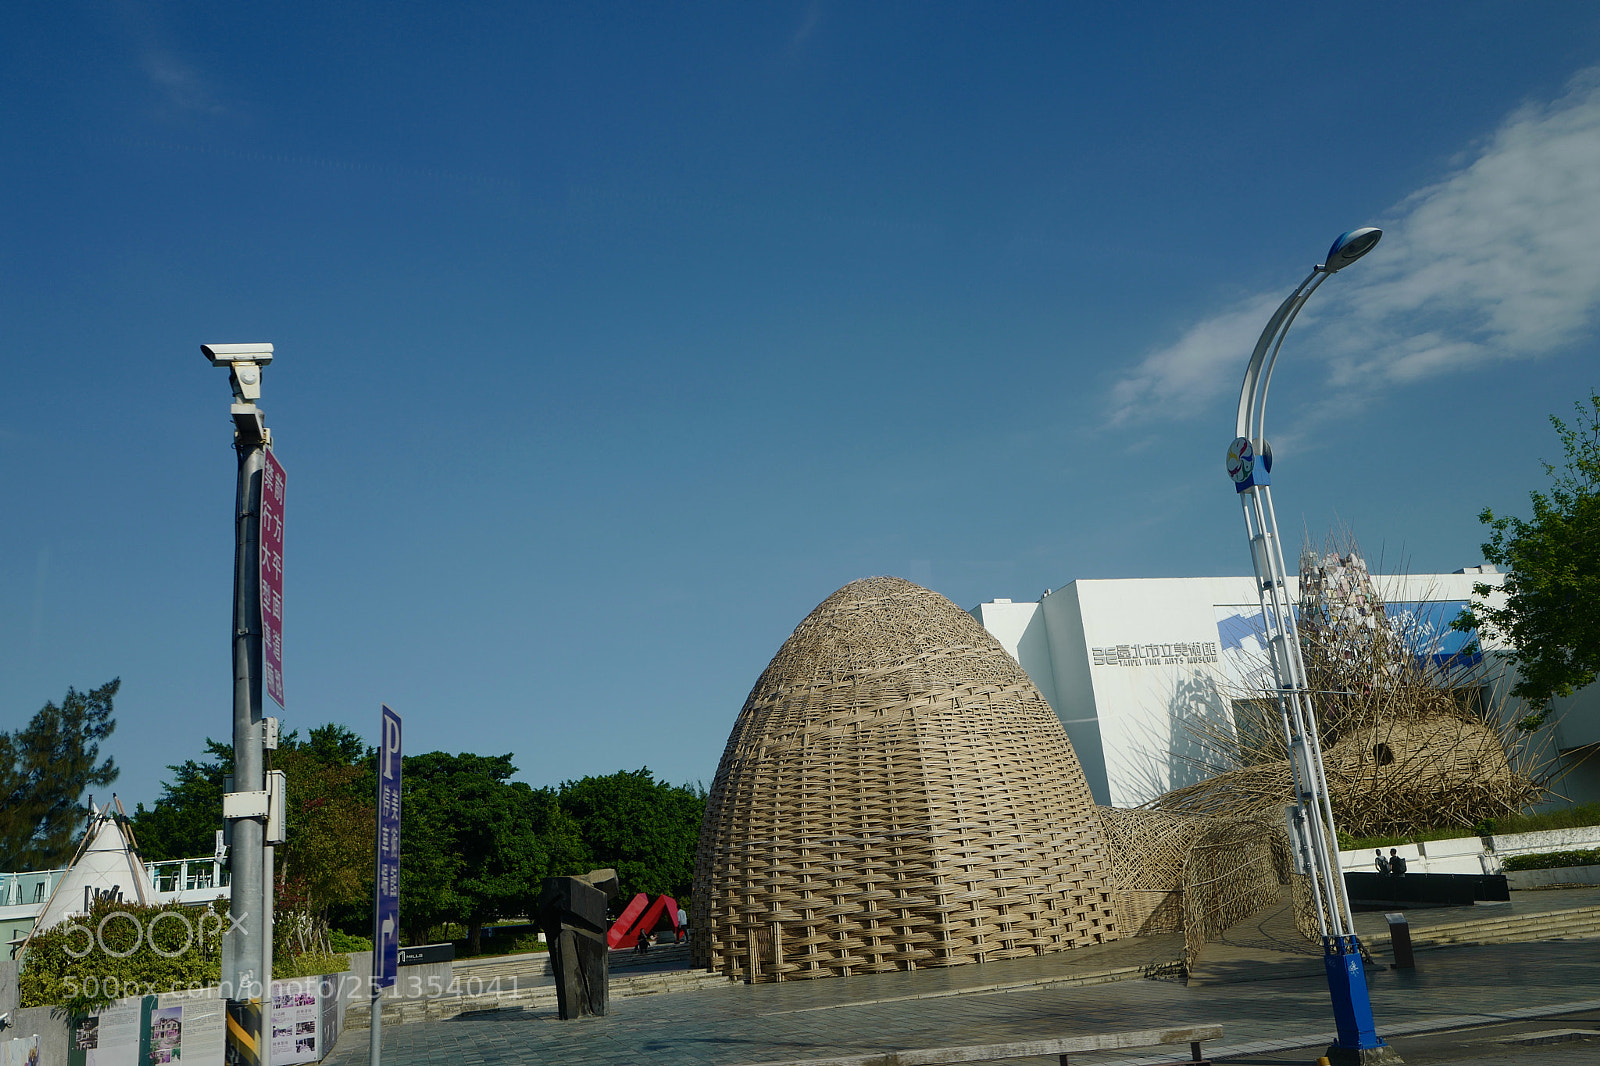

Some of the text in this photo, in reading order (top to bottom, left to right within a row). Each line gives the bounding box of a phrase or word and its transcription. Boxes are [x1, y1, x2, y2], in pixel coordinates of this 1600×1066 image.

[1116, 642, 1217, 660] 臺北市立美術館
[1119, 655, 1218, 667] TAIPEI FINE ARTS MUSEUM
[383, 713, 401, 781] P
[390, 788, 399, 898] 美術館
